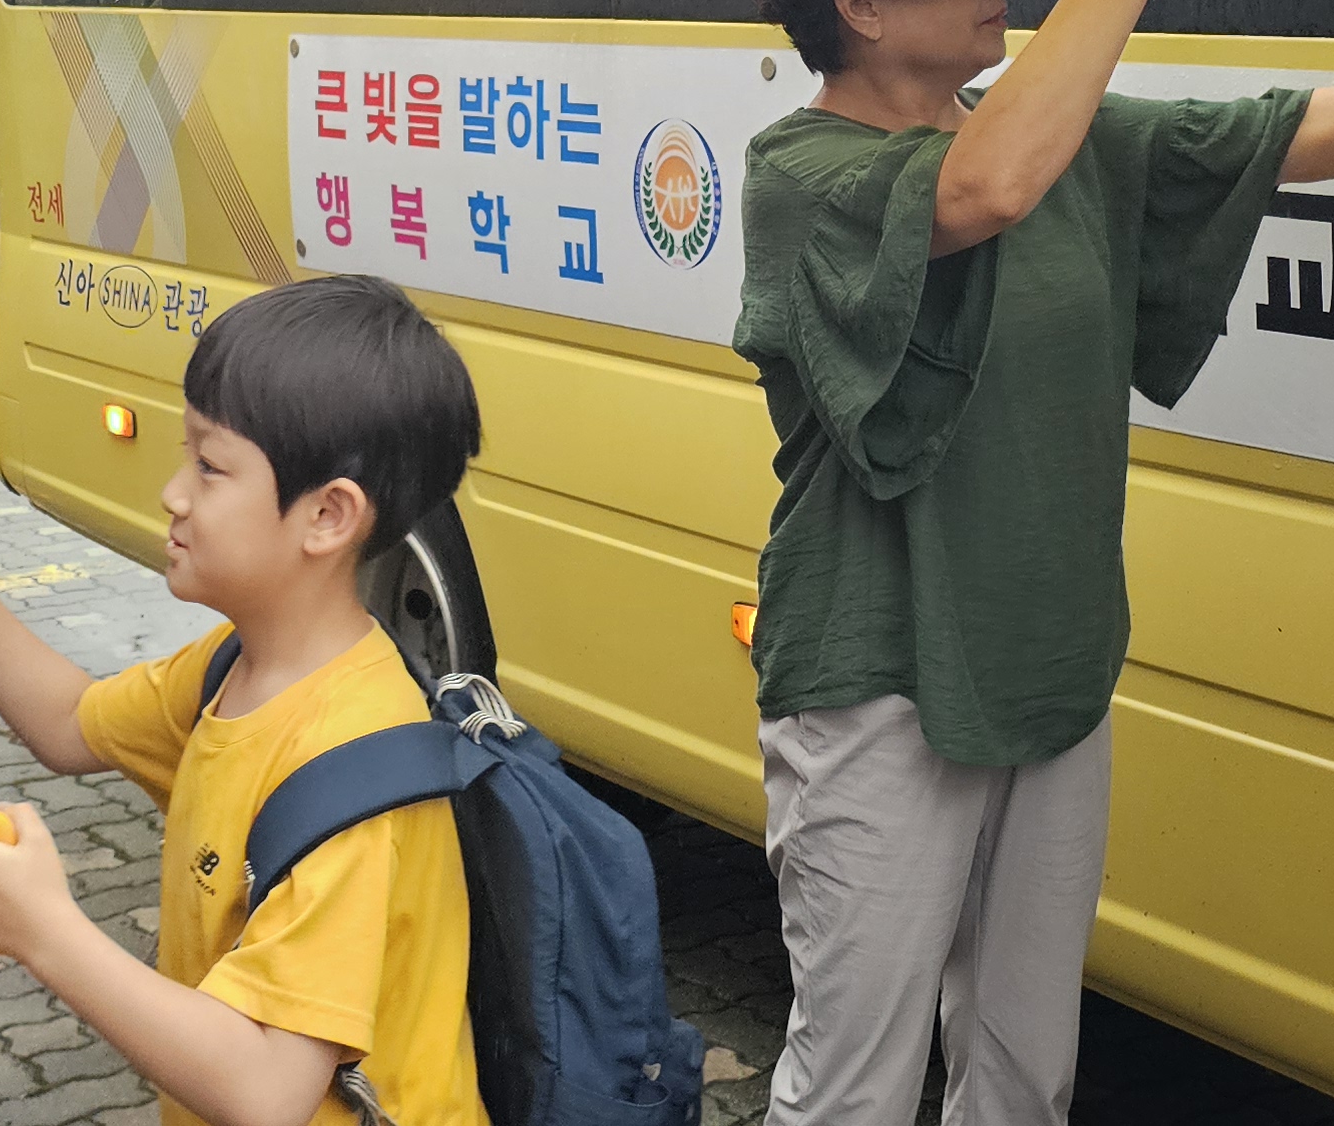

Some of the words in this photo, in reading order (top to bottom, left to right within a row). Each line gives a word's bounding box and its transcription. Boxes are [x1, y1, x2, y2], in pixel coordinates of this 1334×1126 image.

[315, 70, 348, 140] 큰
[363, 71, 442, 149] 빛을
[459, 76, 602, 165] 발하는
[27, 182, 65, 227] 전세
[55, 259, 95, 312] 신아
[103, 277, 152, 316] SHINA
[163, 281, 209, 337] 관광
